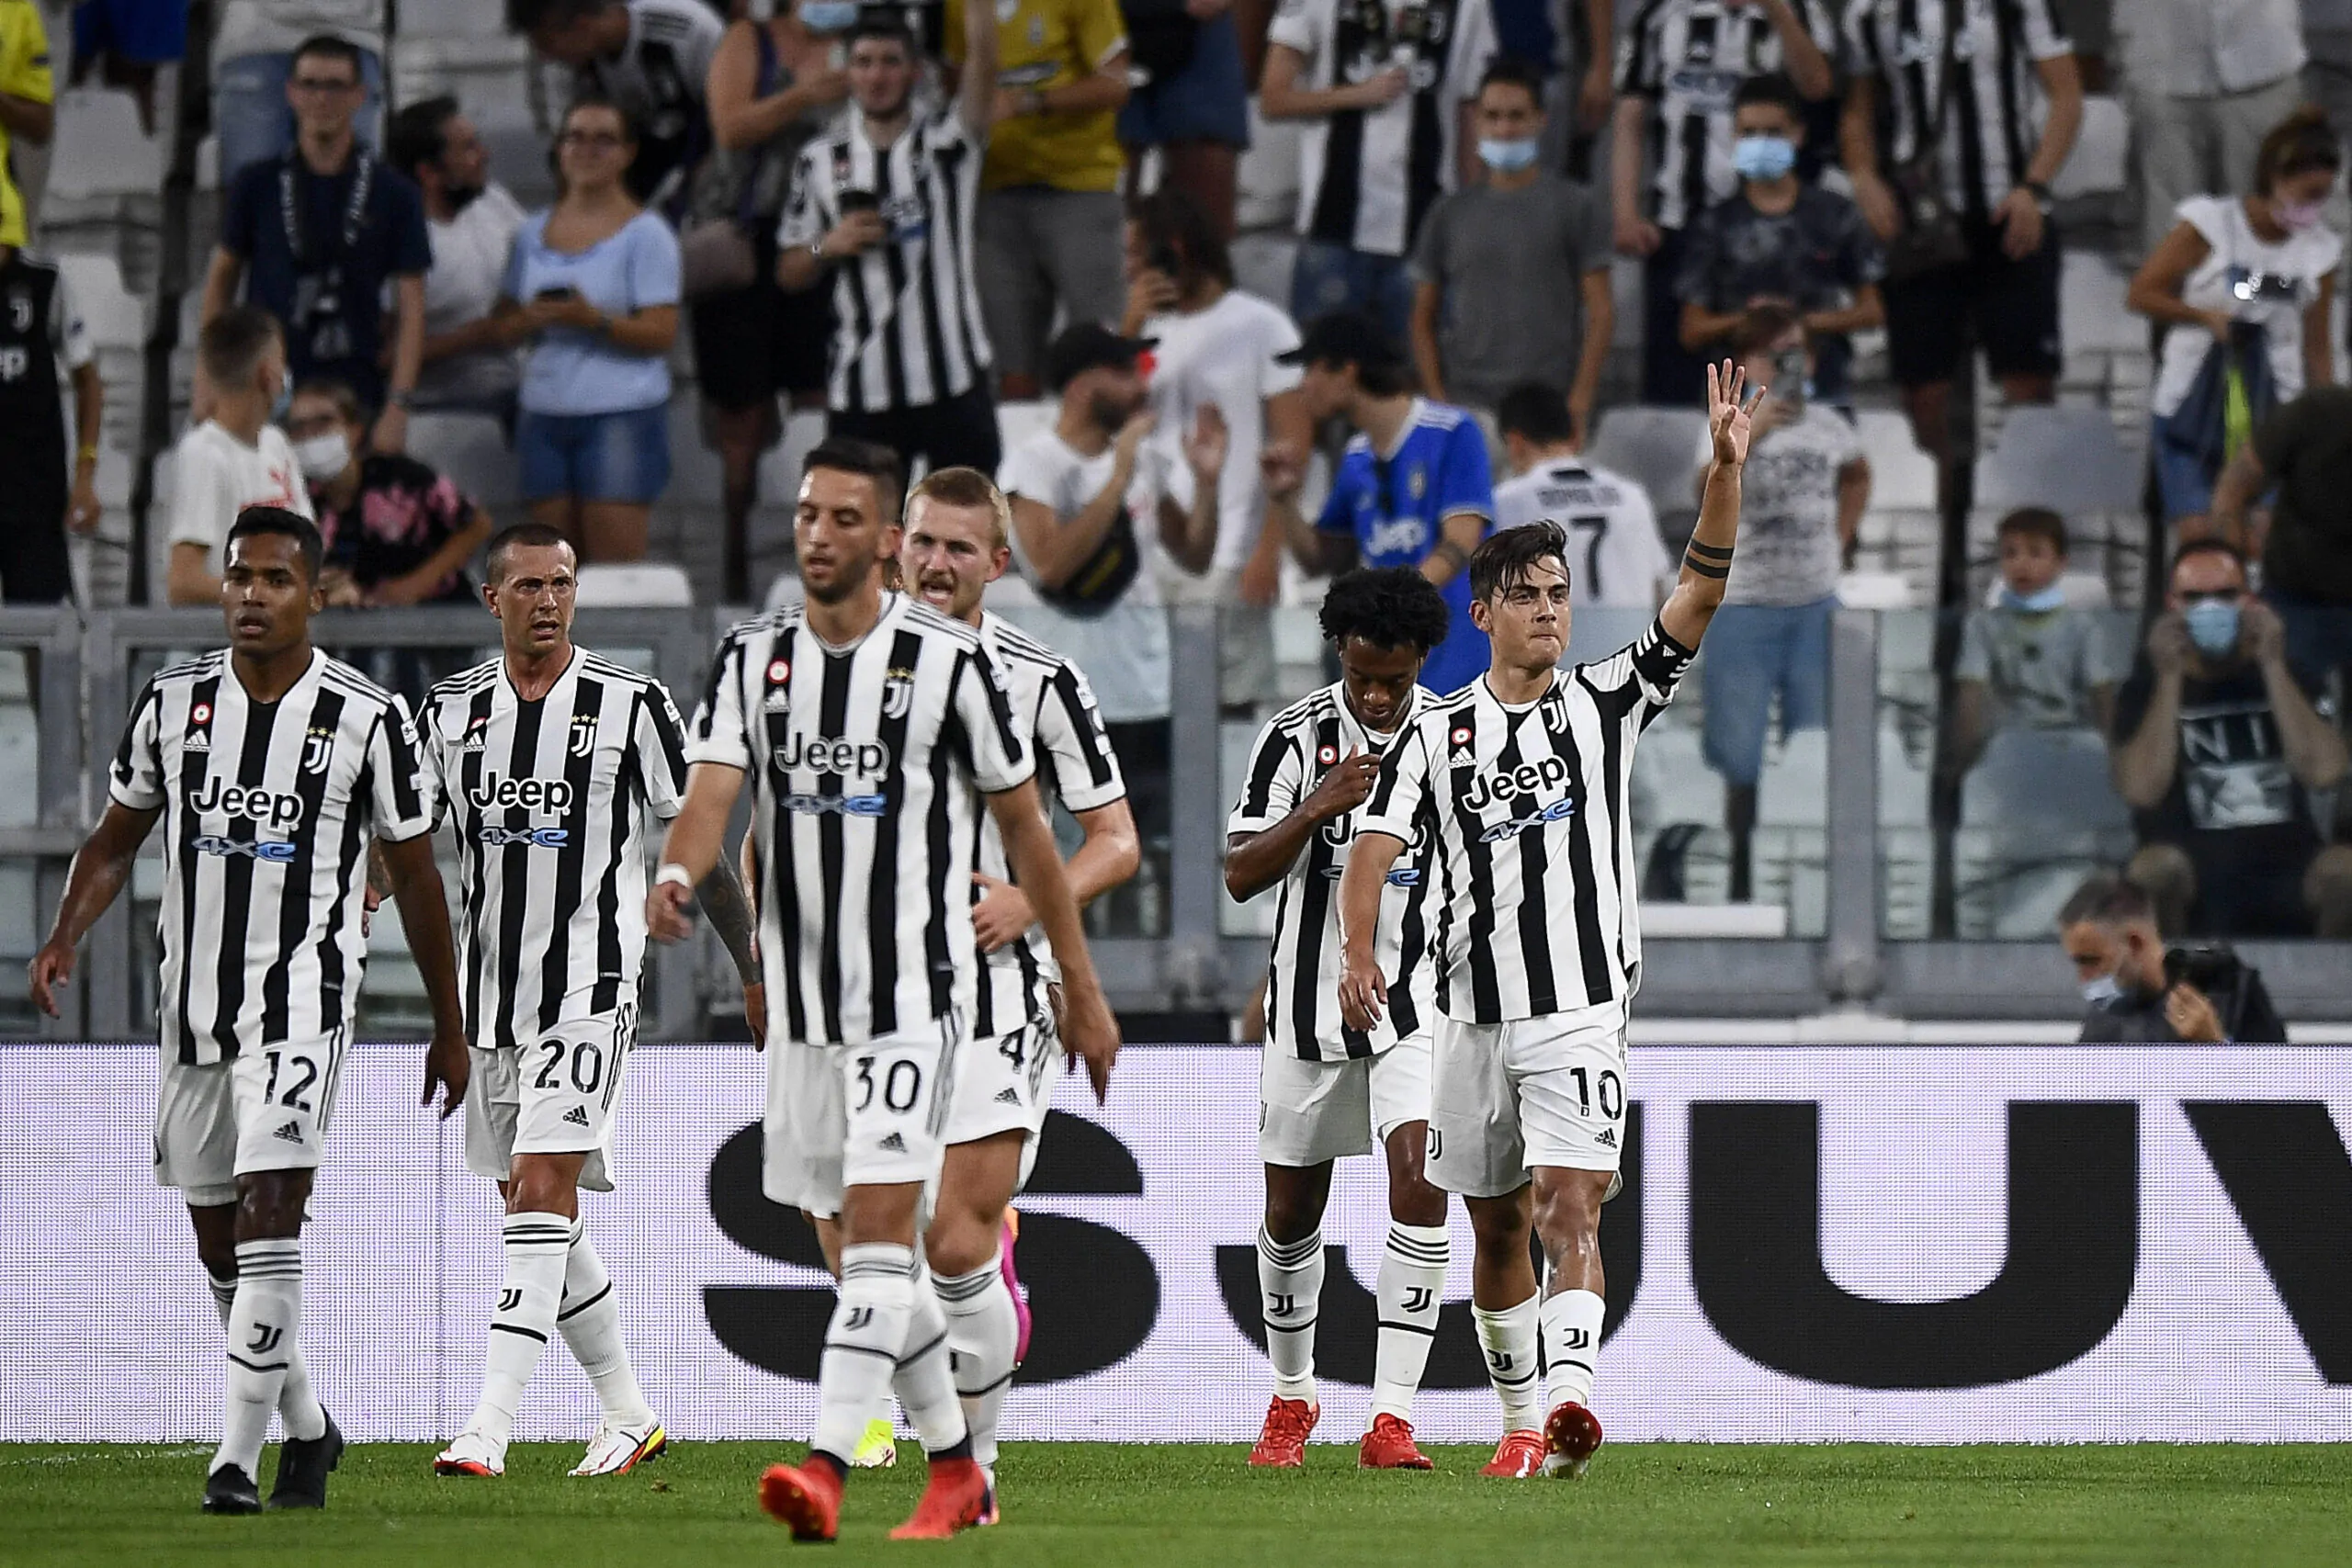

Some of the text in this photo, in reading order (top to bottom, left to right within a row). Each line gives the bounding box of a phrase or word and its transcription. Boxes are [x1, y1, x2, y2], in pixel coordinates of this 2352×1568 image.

[1569, 514, 1609, 602] 7
[775, 732, 889, 781] Jeep
[1462, 754, 1572, 813] Jeep
[190, 774, 304, 831] Jeep
[471, 770, 572, 818] Jeep
[534, 1038, 603, 1094] 20
[999, 1027, 1025, 1075] 4
[264, 1051, 318, 1114] 12
[855, 1055, 922, 1113] 30
[1569, 1066, 1623, 1121] 10
